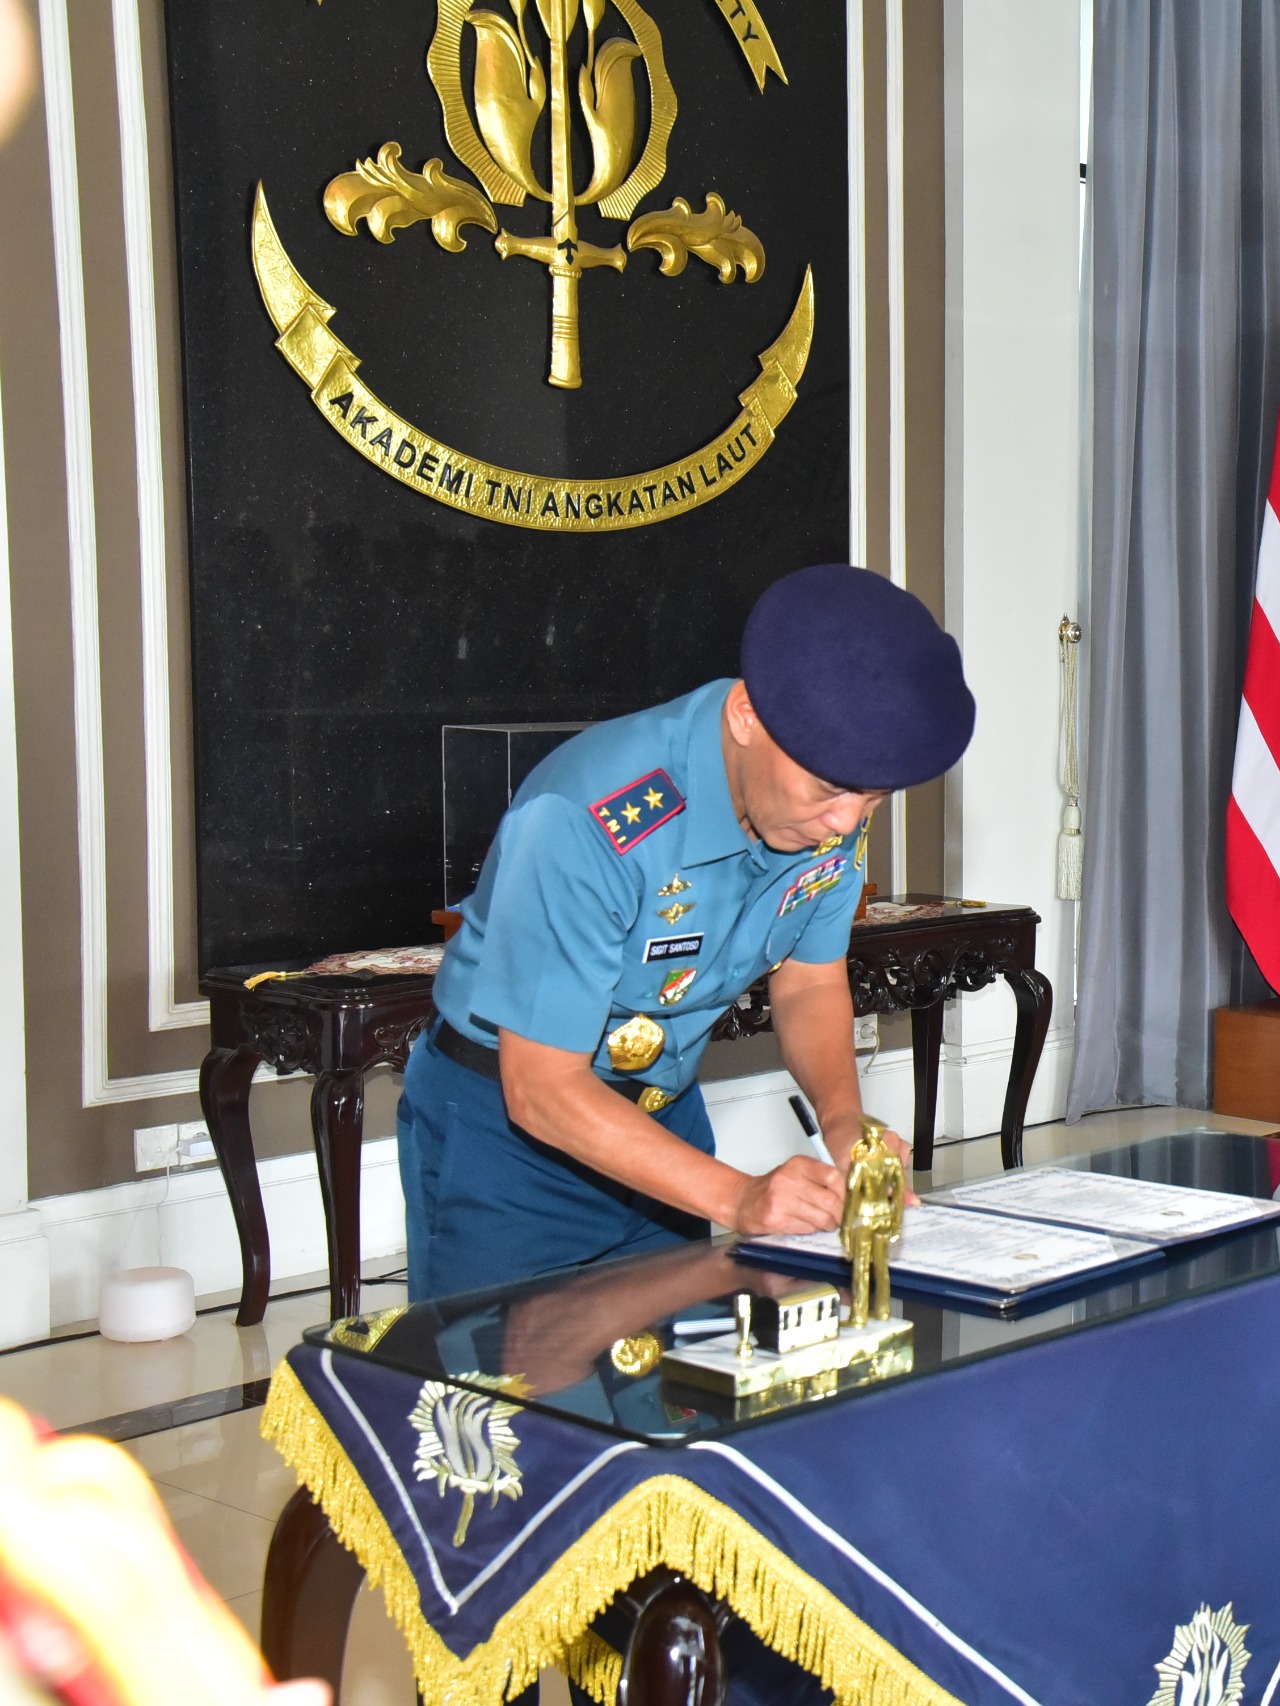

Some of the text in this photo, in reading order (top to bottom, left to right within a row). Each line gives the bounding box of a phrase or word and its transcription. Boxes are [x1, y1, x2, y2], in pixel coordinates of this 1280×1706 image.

[718, 0, 760, 43] TY
[328, 390, 759, 520] AKADEMI TNI ANGKATAN LAUT
[599, 807, 627, 844] TNI
[650, 940, 700, 956] SIGIT SANTOSO
